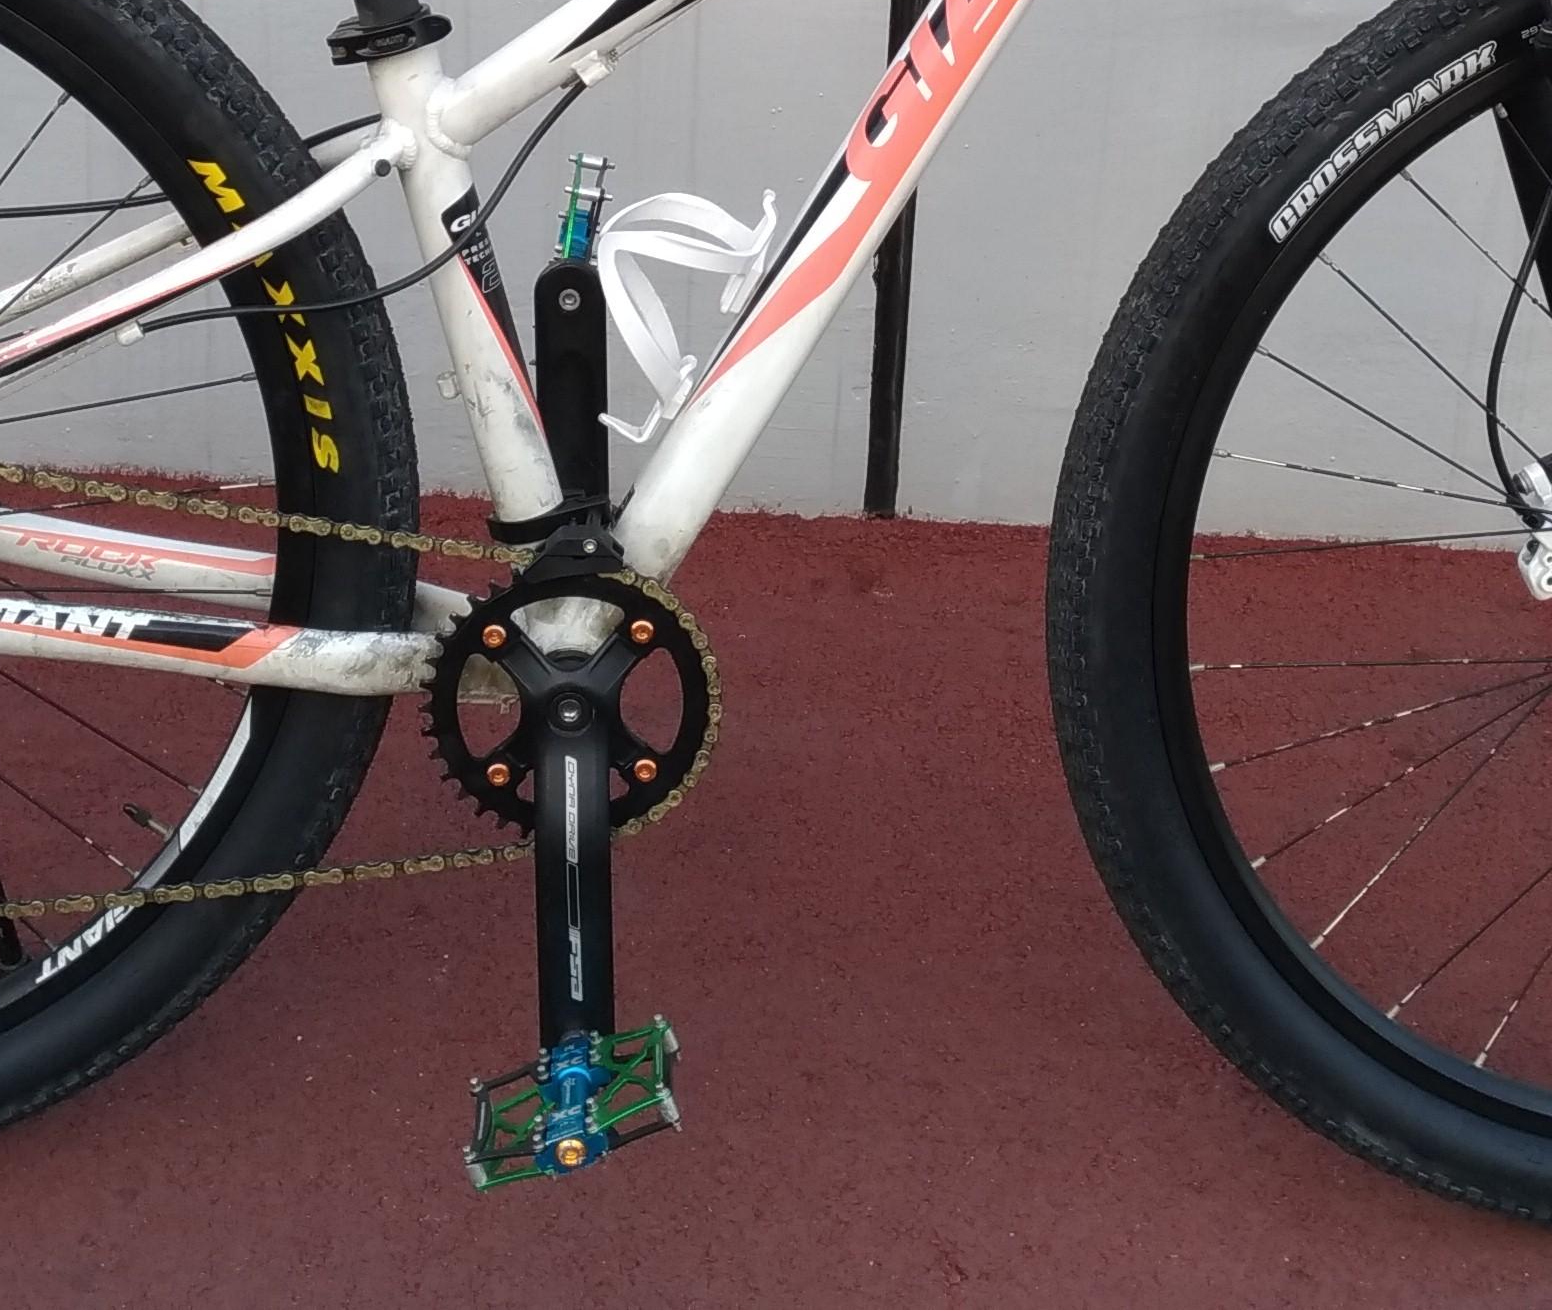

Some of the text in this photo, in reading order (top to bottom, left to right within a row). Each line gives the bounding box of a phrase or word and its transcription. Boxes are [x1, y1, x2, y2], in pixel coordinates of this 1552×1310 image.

[1268, 40, 1498, 243] CROSSMARK
[186, 159, 340, 474] MXXIS
[15, 532, 161, 572] ROCK
[60, 555, 154, 581] ALUXX
[567, 812, 578, 861] DRIVE
[35, 904, 135, 984] GIANT
